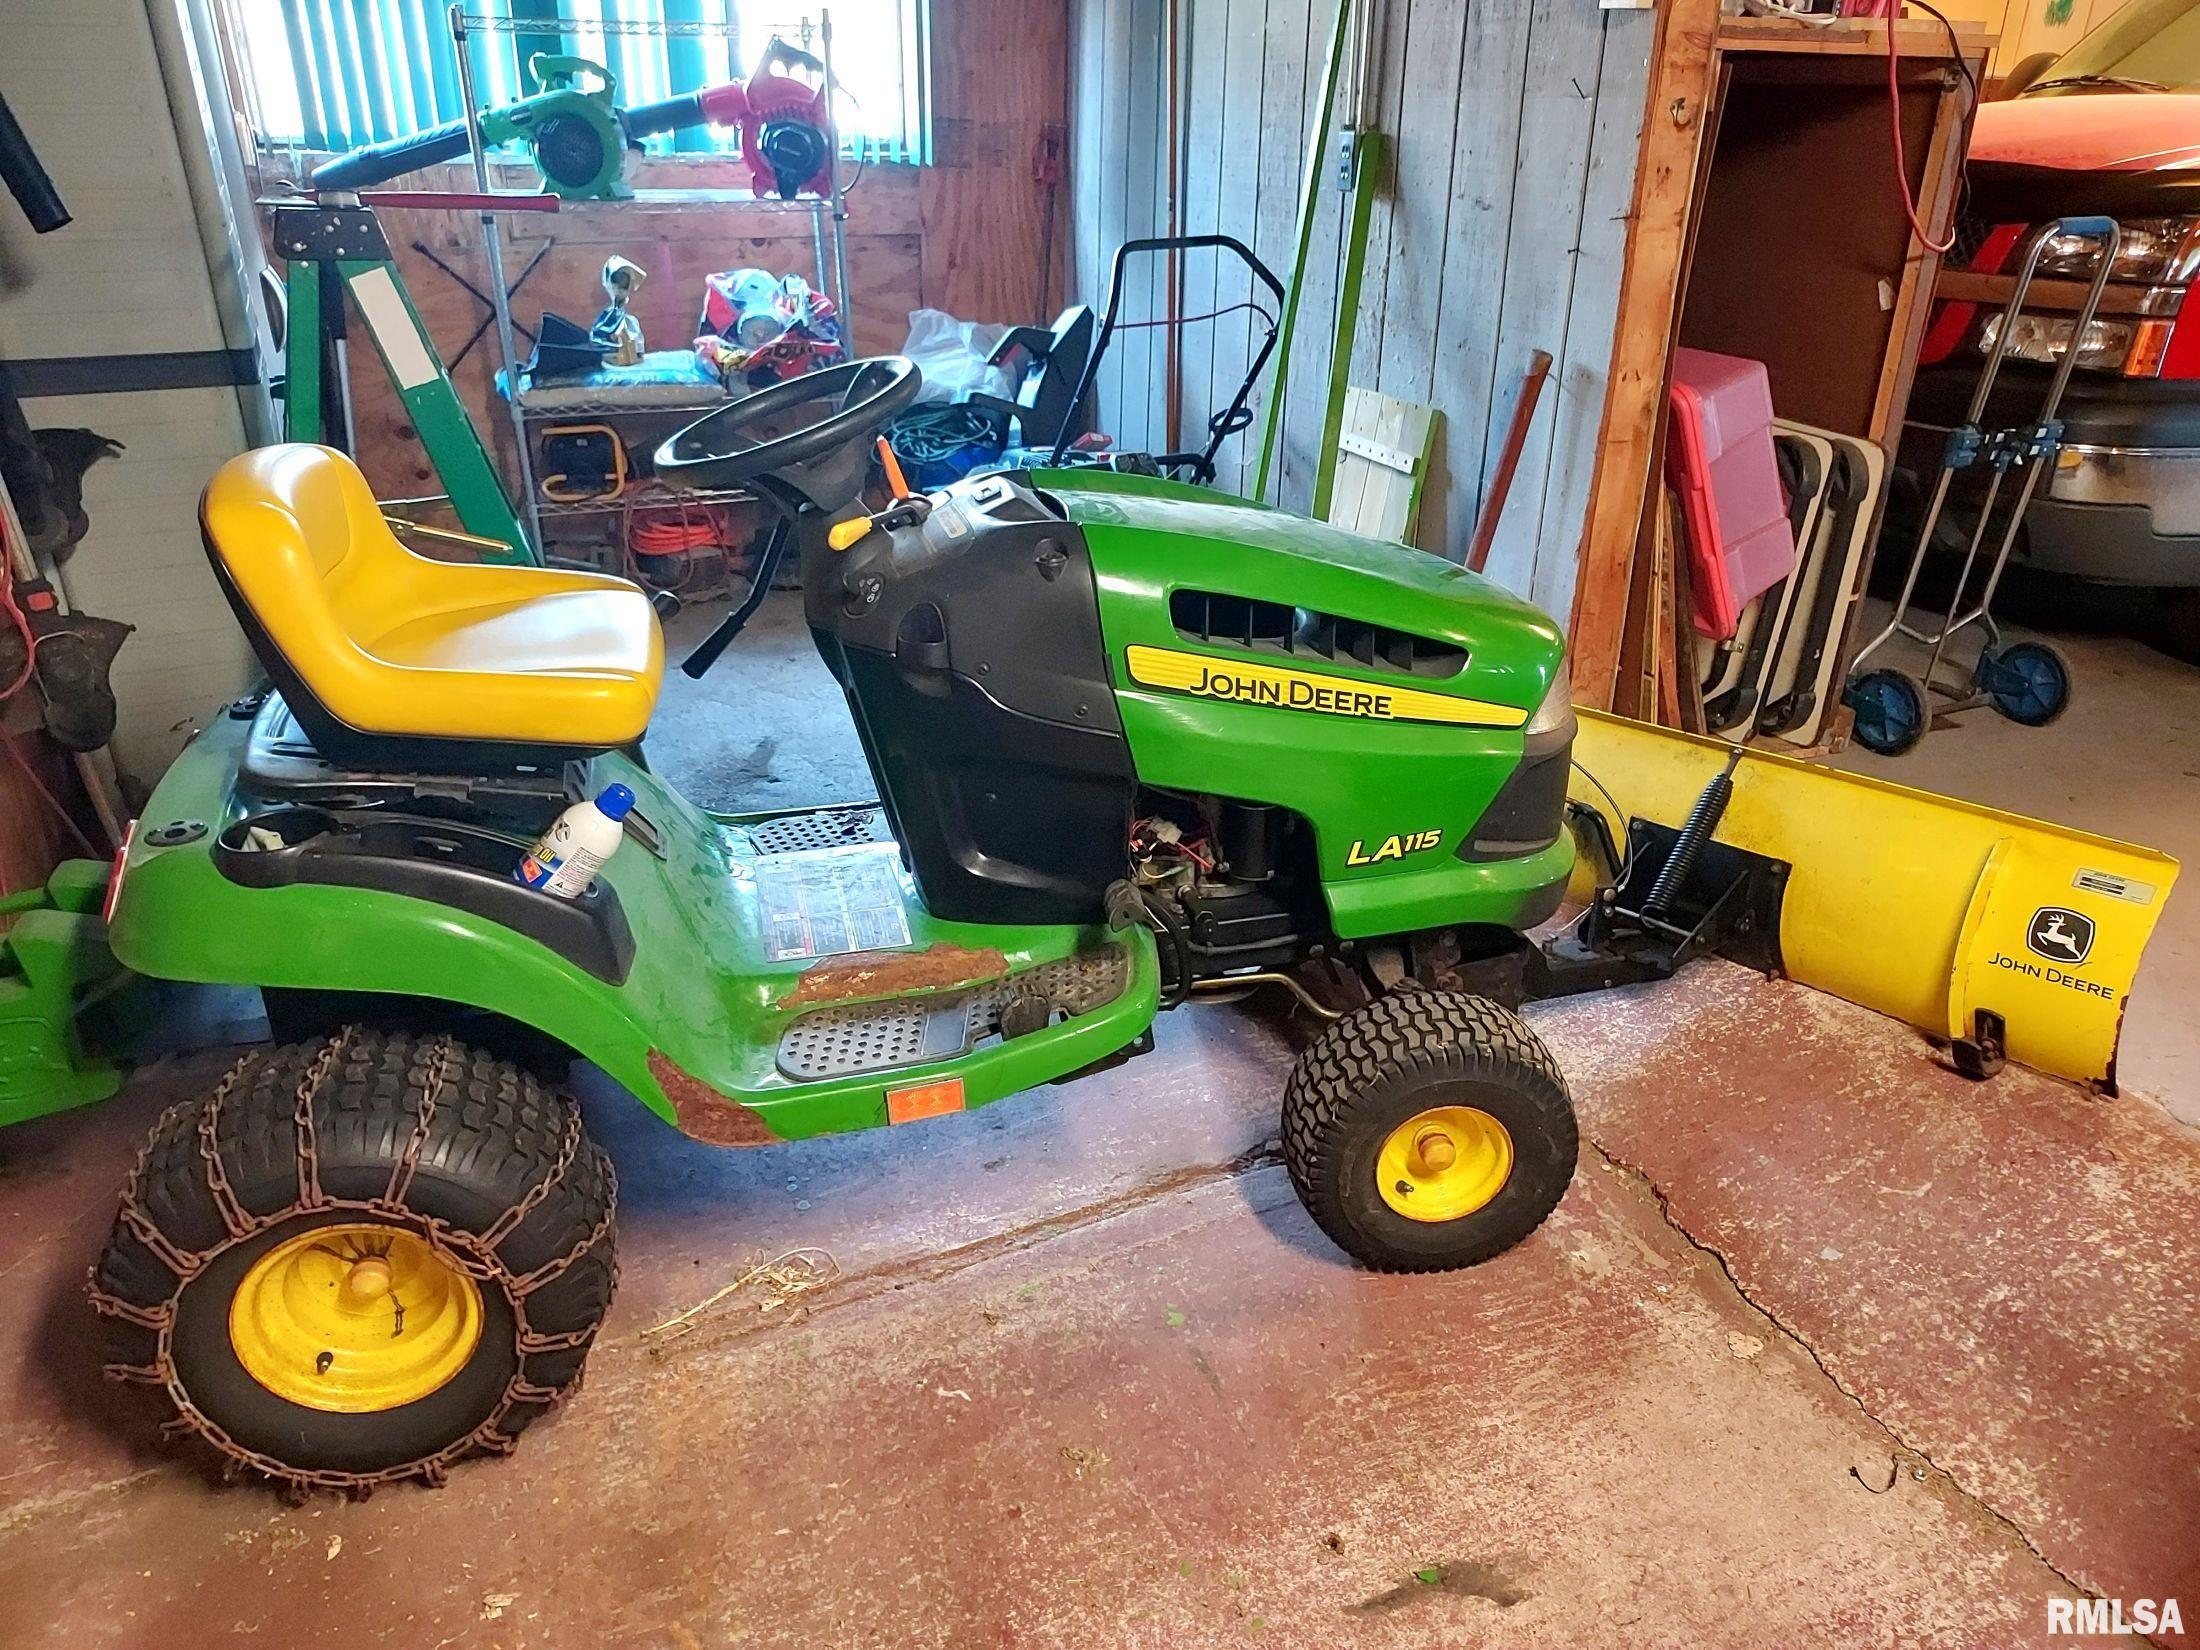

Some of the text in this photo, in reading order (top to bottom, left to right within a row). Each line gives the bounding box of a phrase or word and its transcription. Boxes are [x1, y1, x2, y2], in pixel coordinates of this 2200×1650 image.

[1190, 668, 1392, 715] JOHN DEERE
[1346, 828, 1442, 866] LA115
[1988, 953, 2114, 999] JOHN DEERE
